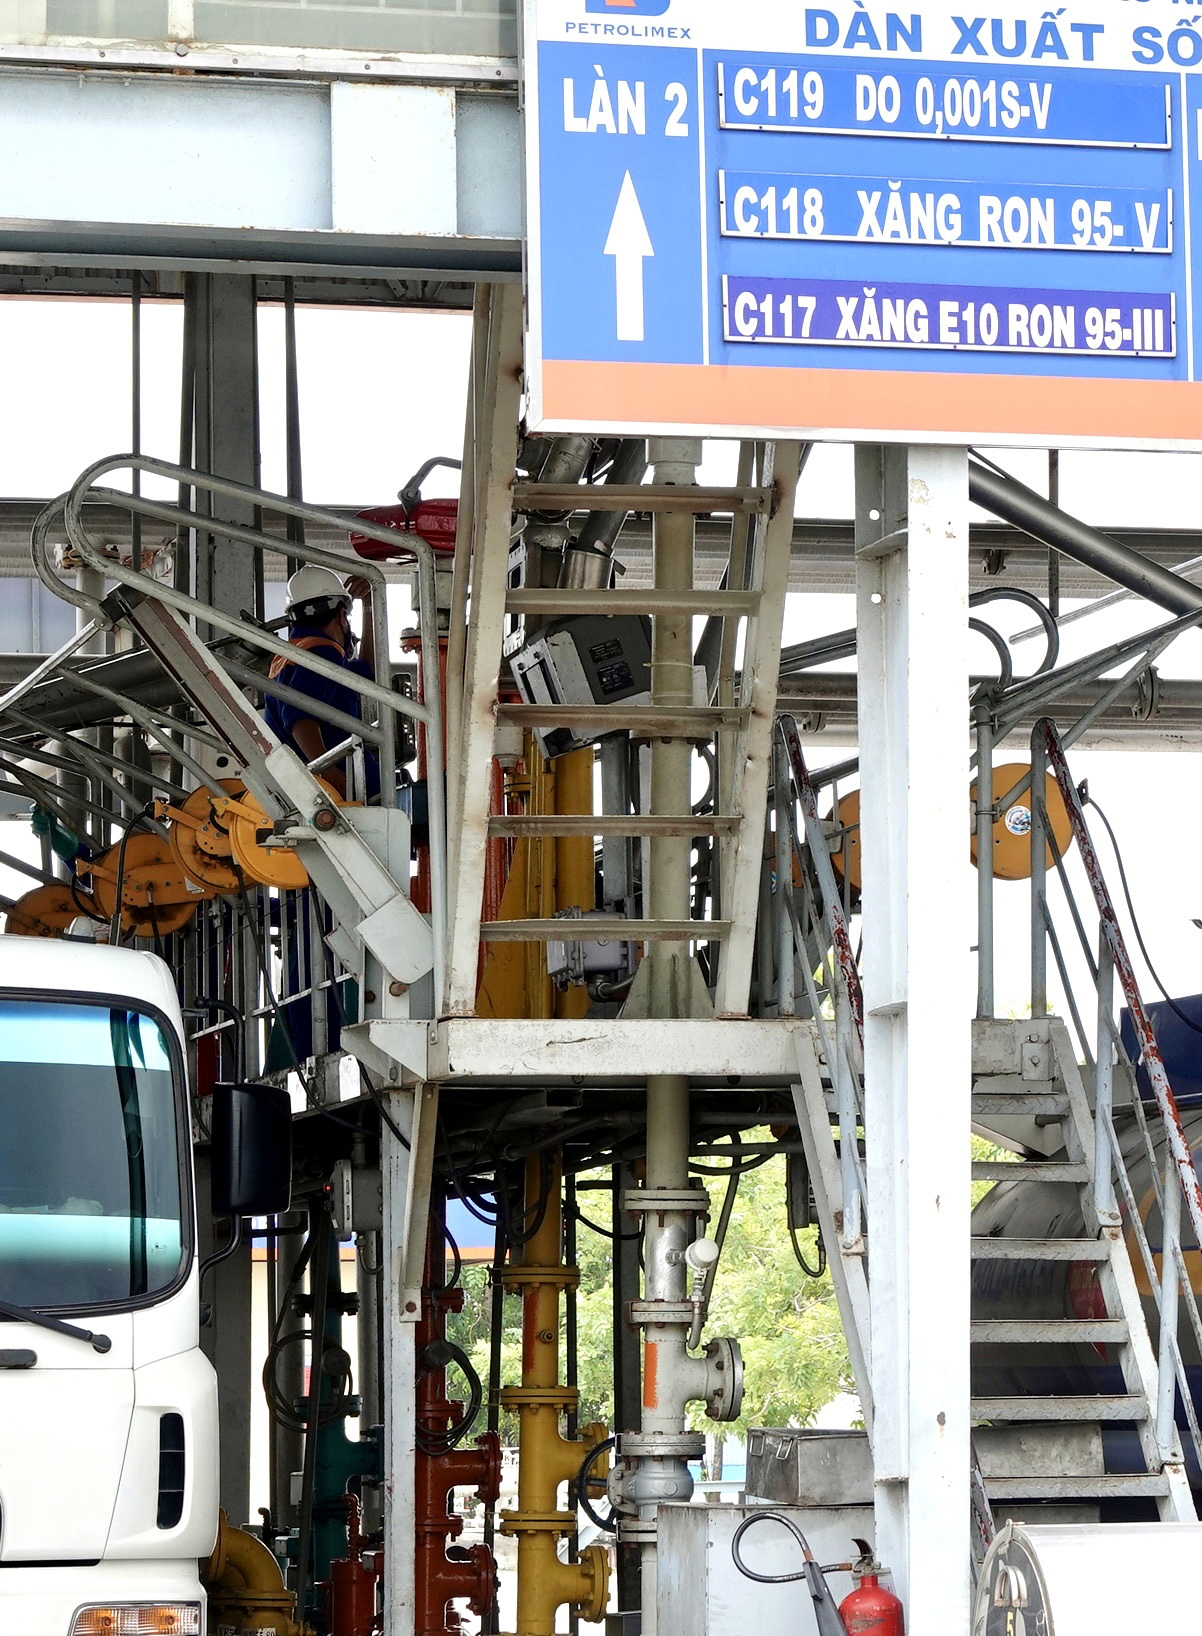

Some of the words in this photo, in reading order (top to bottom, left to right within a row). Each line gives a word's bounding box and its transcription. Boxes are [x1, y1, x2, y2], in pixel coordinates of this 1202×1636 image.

[565, 22, 691, 39] PETROLIMEX
[805, 2, 923, 53] DÀN
[952, 8, 1105, 62] XUẤT
[563, 64, 646, 135] LÀN
[664, 82, 689, 137] 2
[733, 67, 824, 120] C119
[856, 74, 901, 123] DO
[915, 77, 1053, 134] 0,001S-V
[733, 185, 824, 236] C118
[856, 179, 963, 242] XĂNG
[979, 194, 1055, 245] RON
[734, 291, 817, 337] C117
[835, 286, 929, 343] XĂNG
[939, 300, 999, 346] E10
[1008, 302, 1075, 348] RON
[1084, 307, 1164, 351] 95-III
